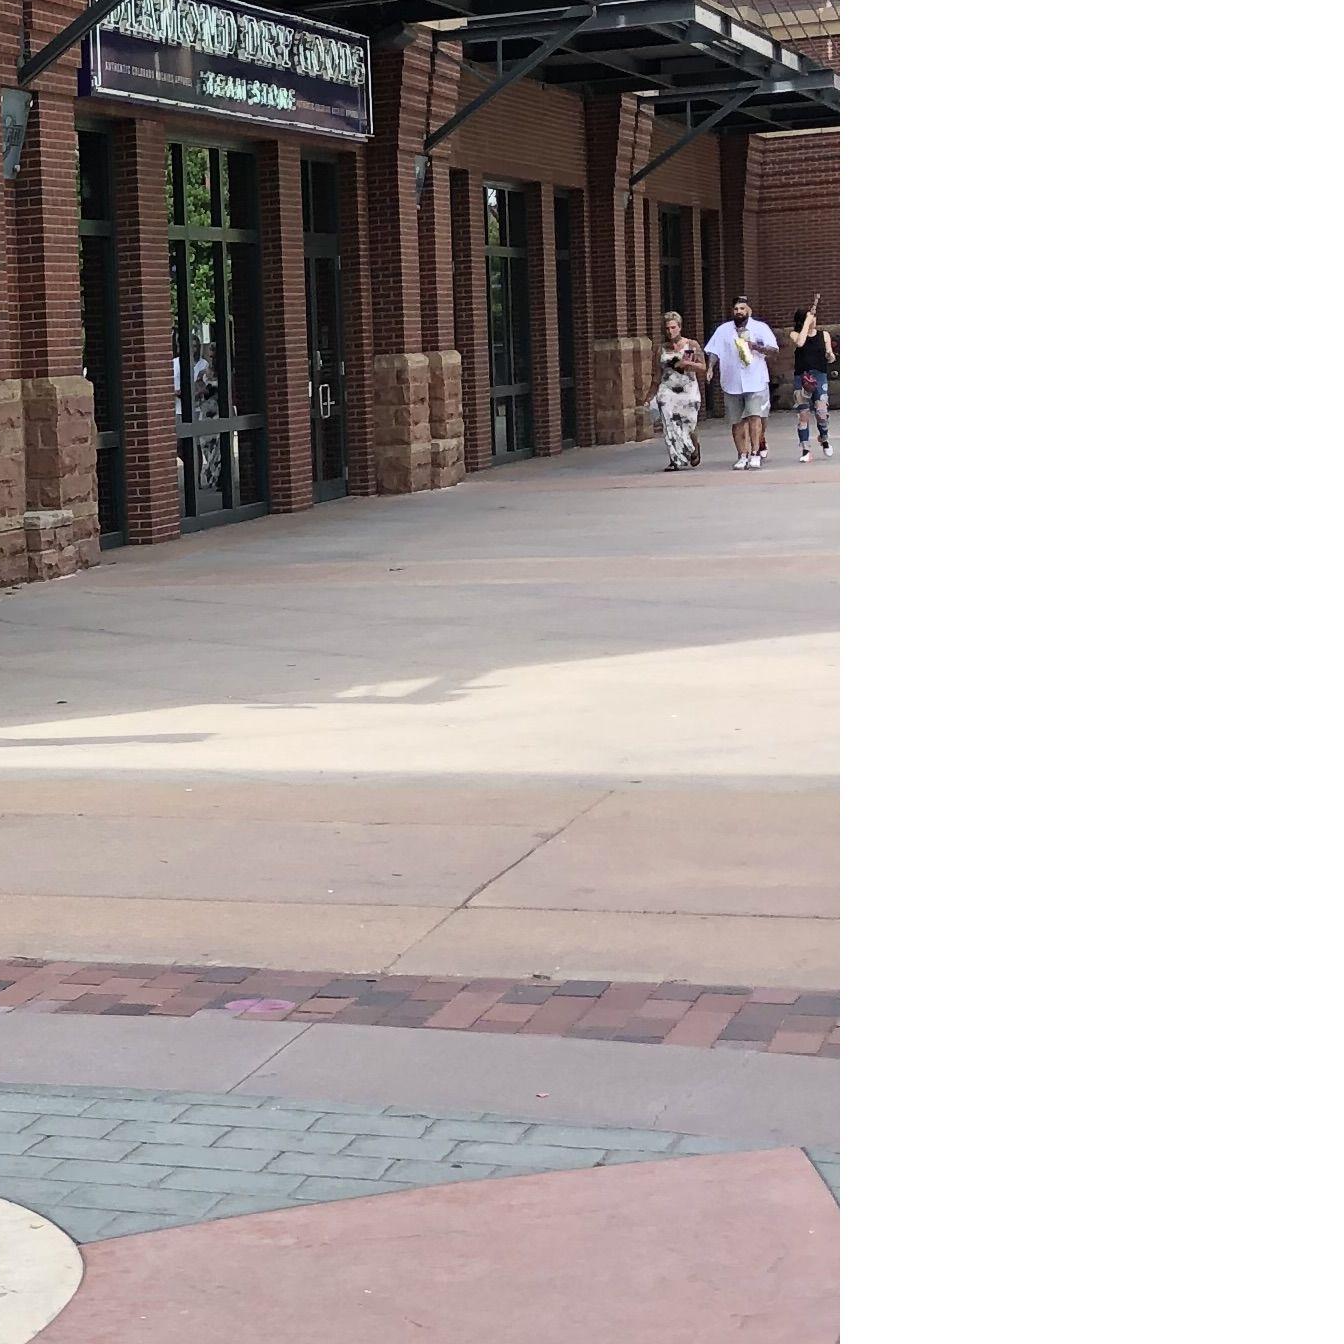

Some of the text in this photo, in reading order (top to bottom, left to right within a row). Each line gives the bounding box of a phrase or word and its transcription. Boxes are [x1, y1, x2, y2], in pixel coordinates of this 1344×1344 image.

[237, 14, 294, 70] DRY
[293, 31, 365, 87] GOODS
[200, 70, 247, 102] TEAM
[247, 79, 296, 112] STORE
